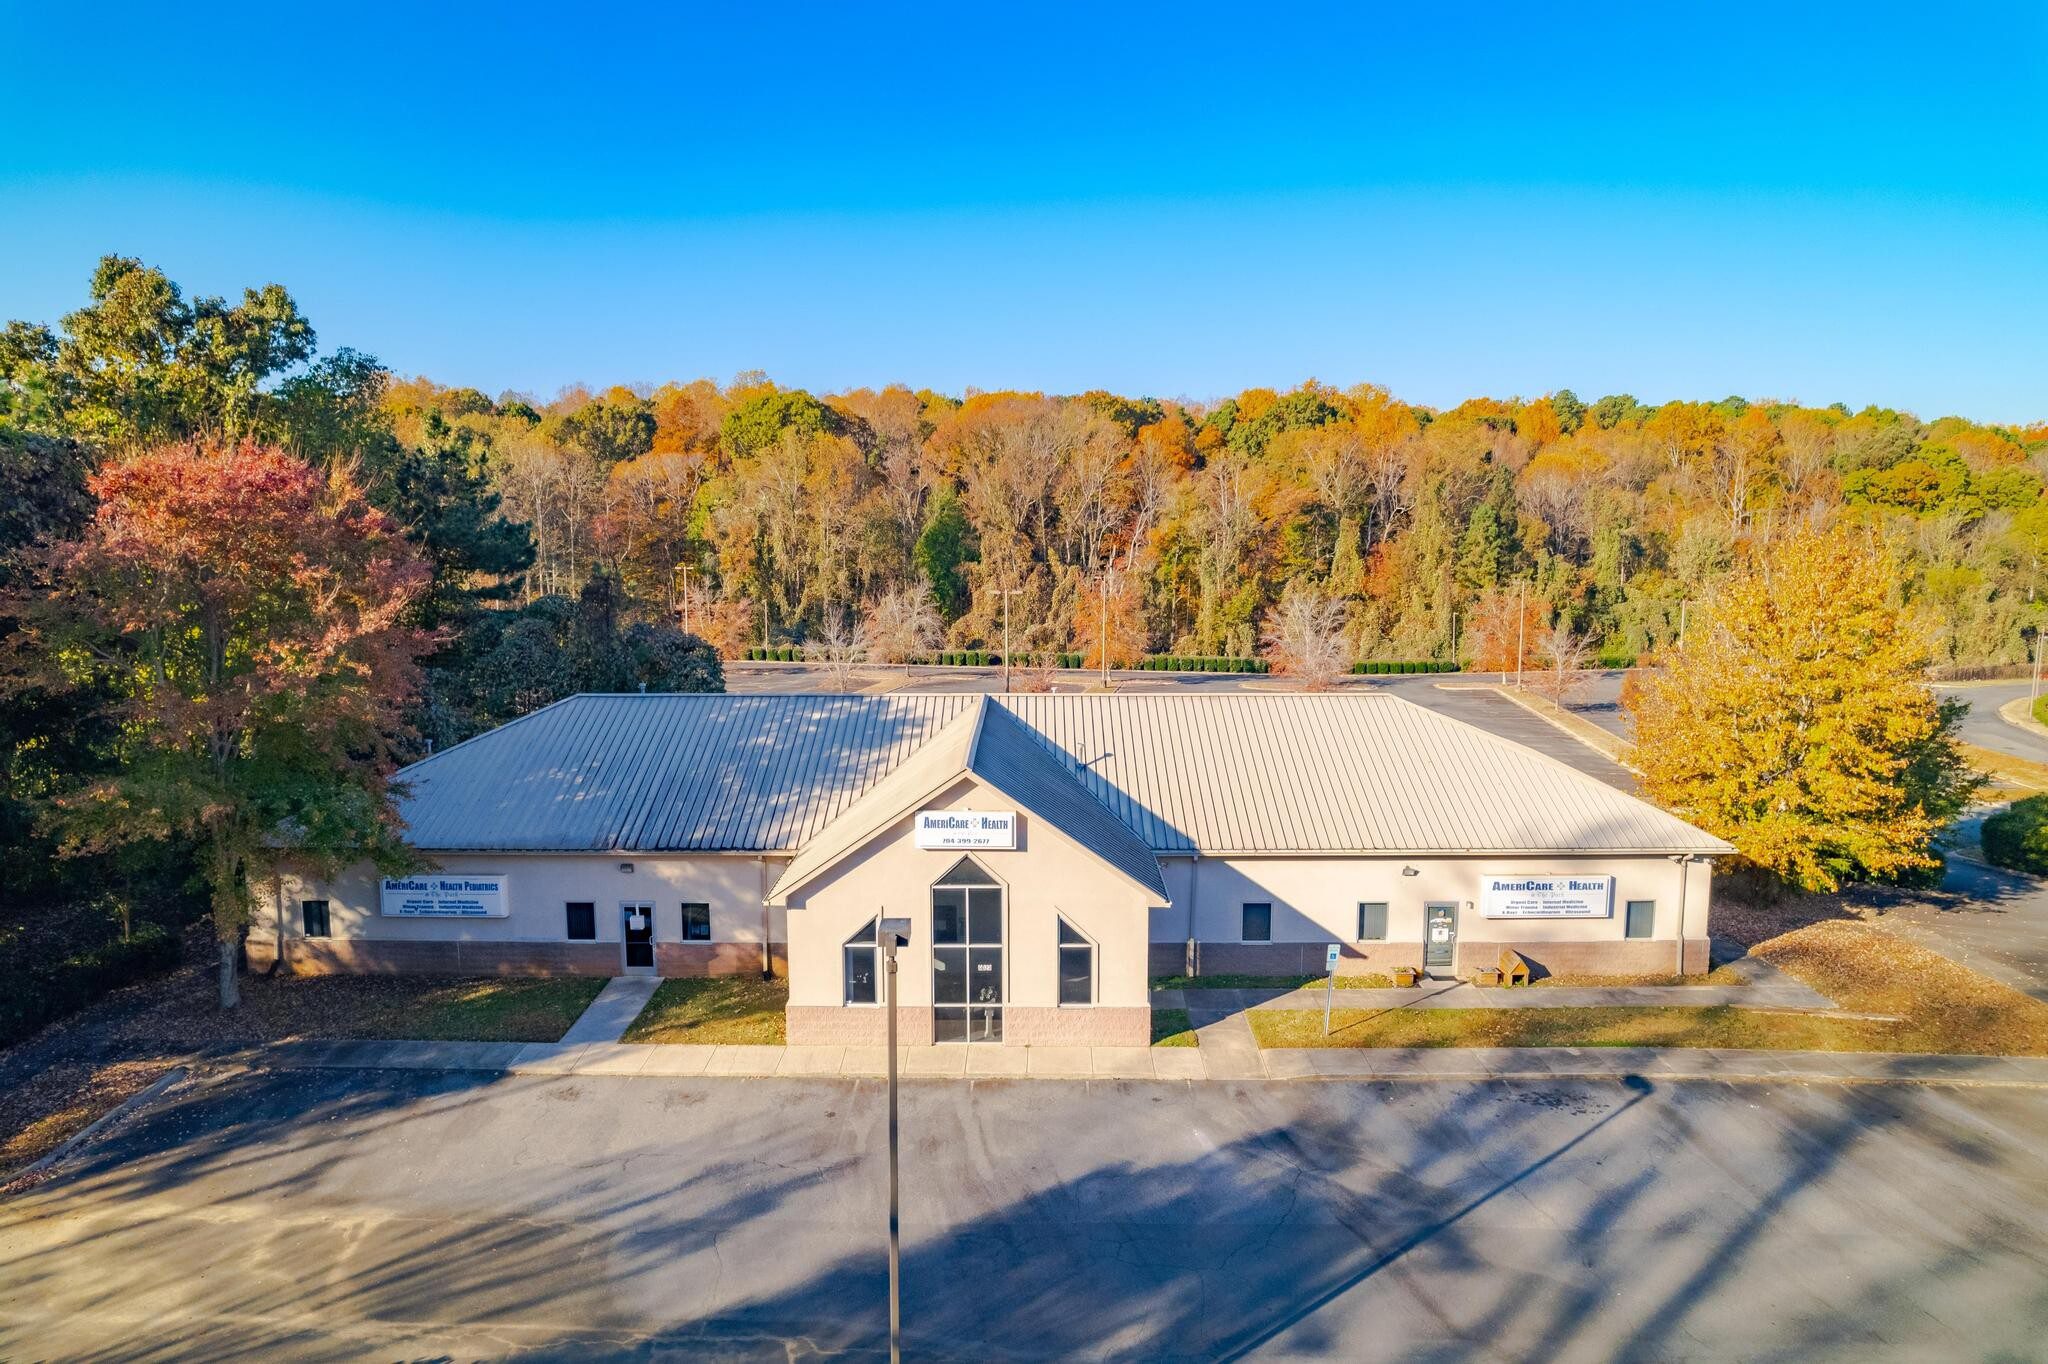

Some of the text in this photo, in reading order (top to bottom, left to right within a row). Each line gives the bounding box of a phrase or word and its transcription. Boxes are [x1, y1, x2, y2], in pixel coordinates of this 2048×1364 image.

[923, 816, 1008, 830] AMERICARE HEALTH
[440, 880, 463, 891] HEALTH
[465, 881, 499, 891] PEDIATRICS
[1492, 880, 1604, 891] AMERICARE HEALTH
